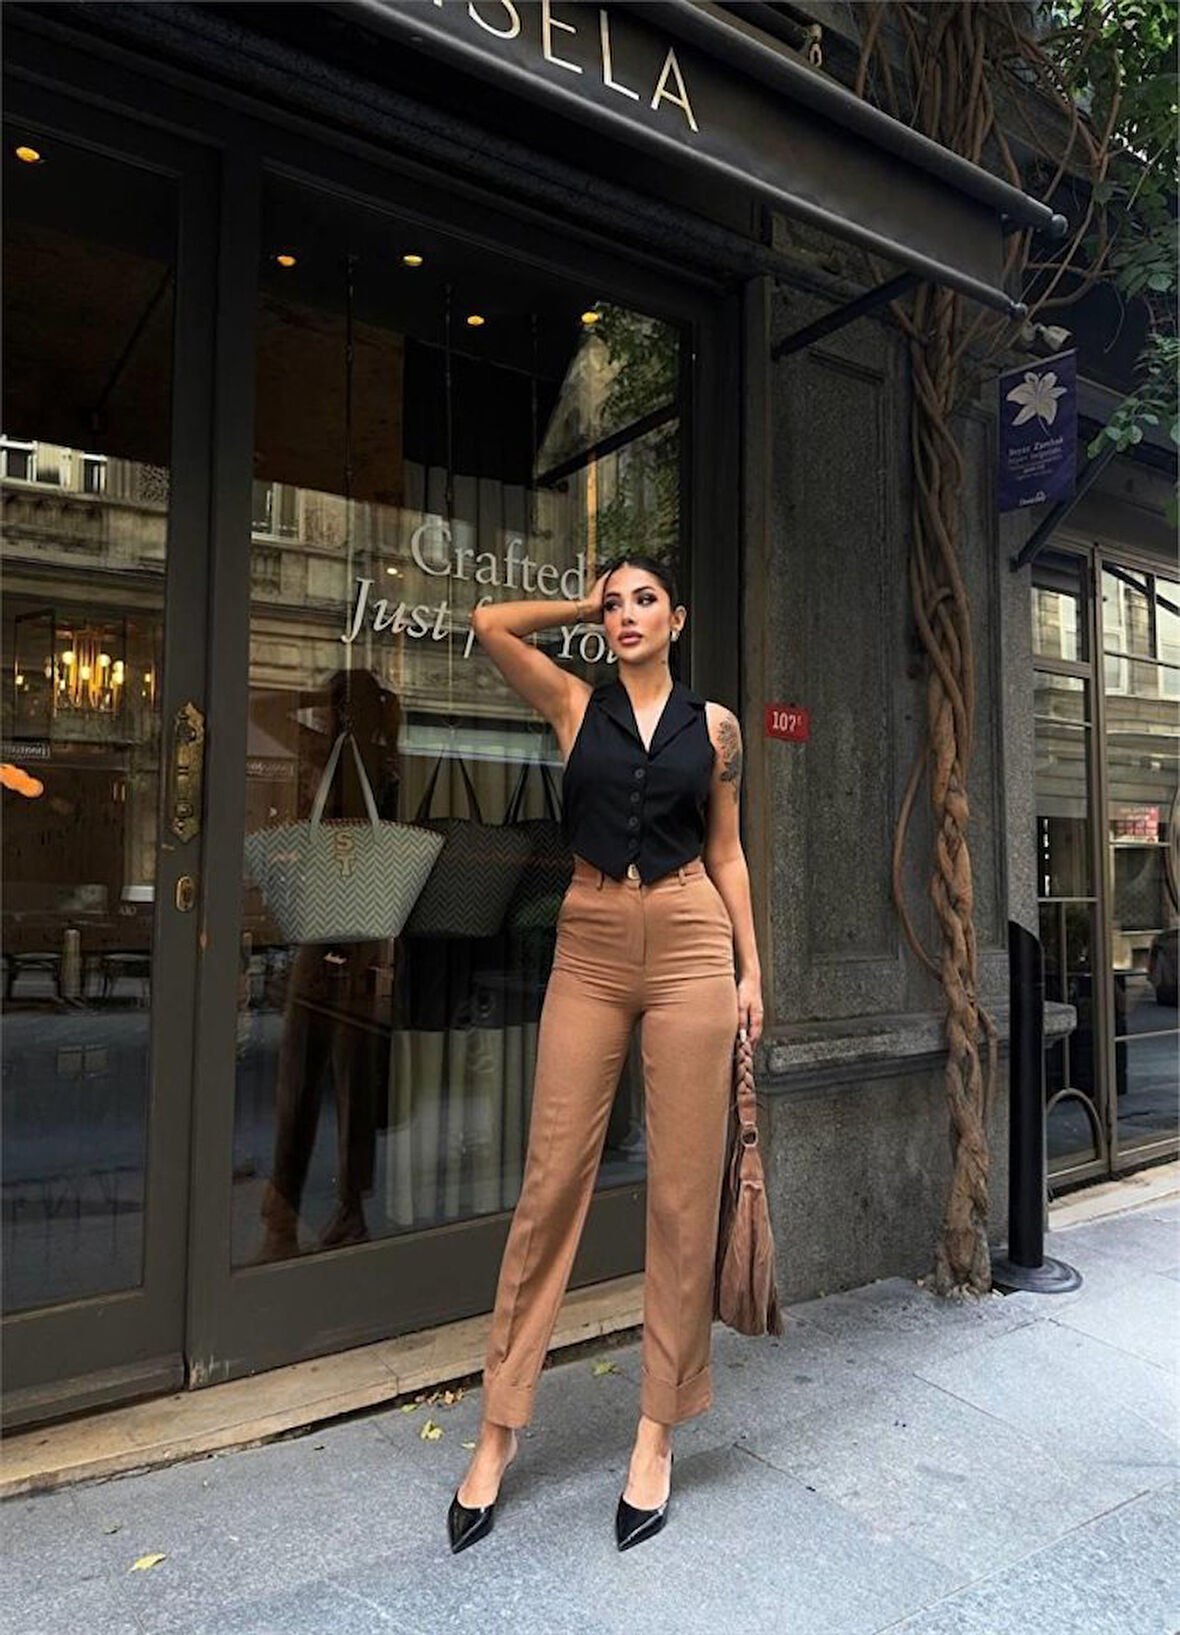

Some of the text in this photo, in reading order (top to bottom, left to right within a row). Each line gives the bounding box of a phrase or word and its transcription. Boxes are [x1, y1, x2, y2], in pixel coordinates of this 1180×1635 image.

[410, 523, 586, 601] Crafted
[341, 577, 451, 644] Just
[557, 625, 618, 665] Yo
